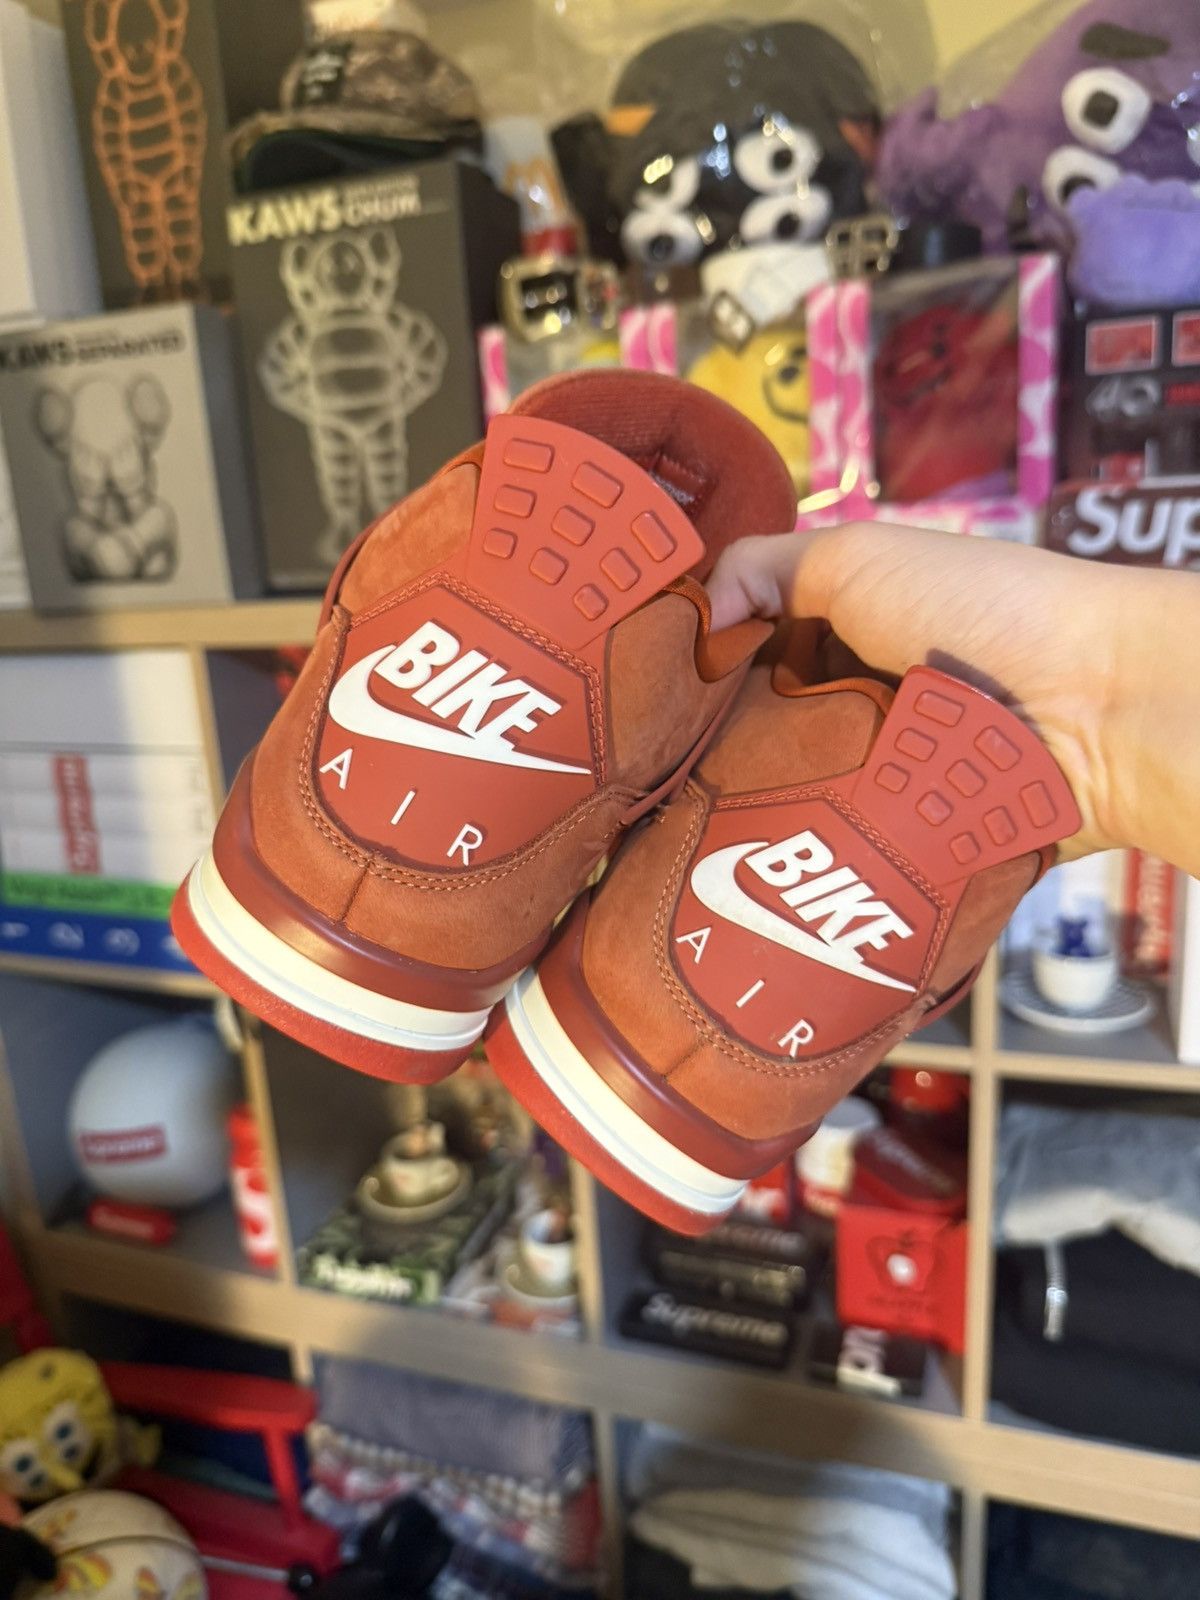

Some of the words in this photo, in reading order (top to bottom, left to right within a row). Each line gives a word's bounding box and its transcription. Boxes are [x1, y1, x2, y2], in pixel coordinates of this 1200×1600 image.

[226, 188, 341, 246] KAWS
[373, 620, 562, 751] BIKE
[319, 748, 483, 866] AIR
[744, 830, 914, 964] BIKE
[676, 926, 815, 1058] AIR
